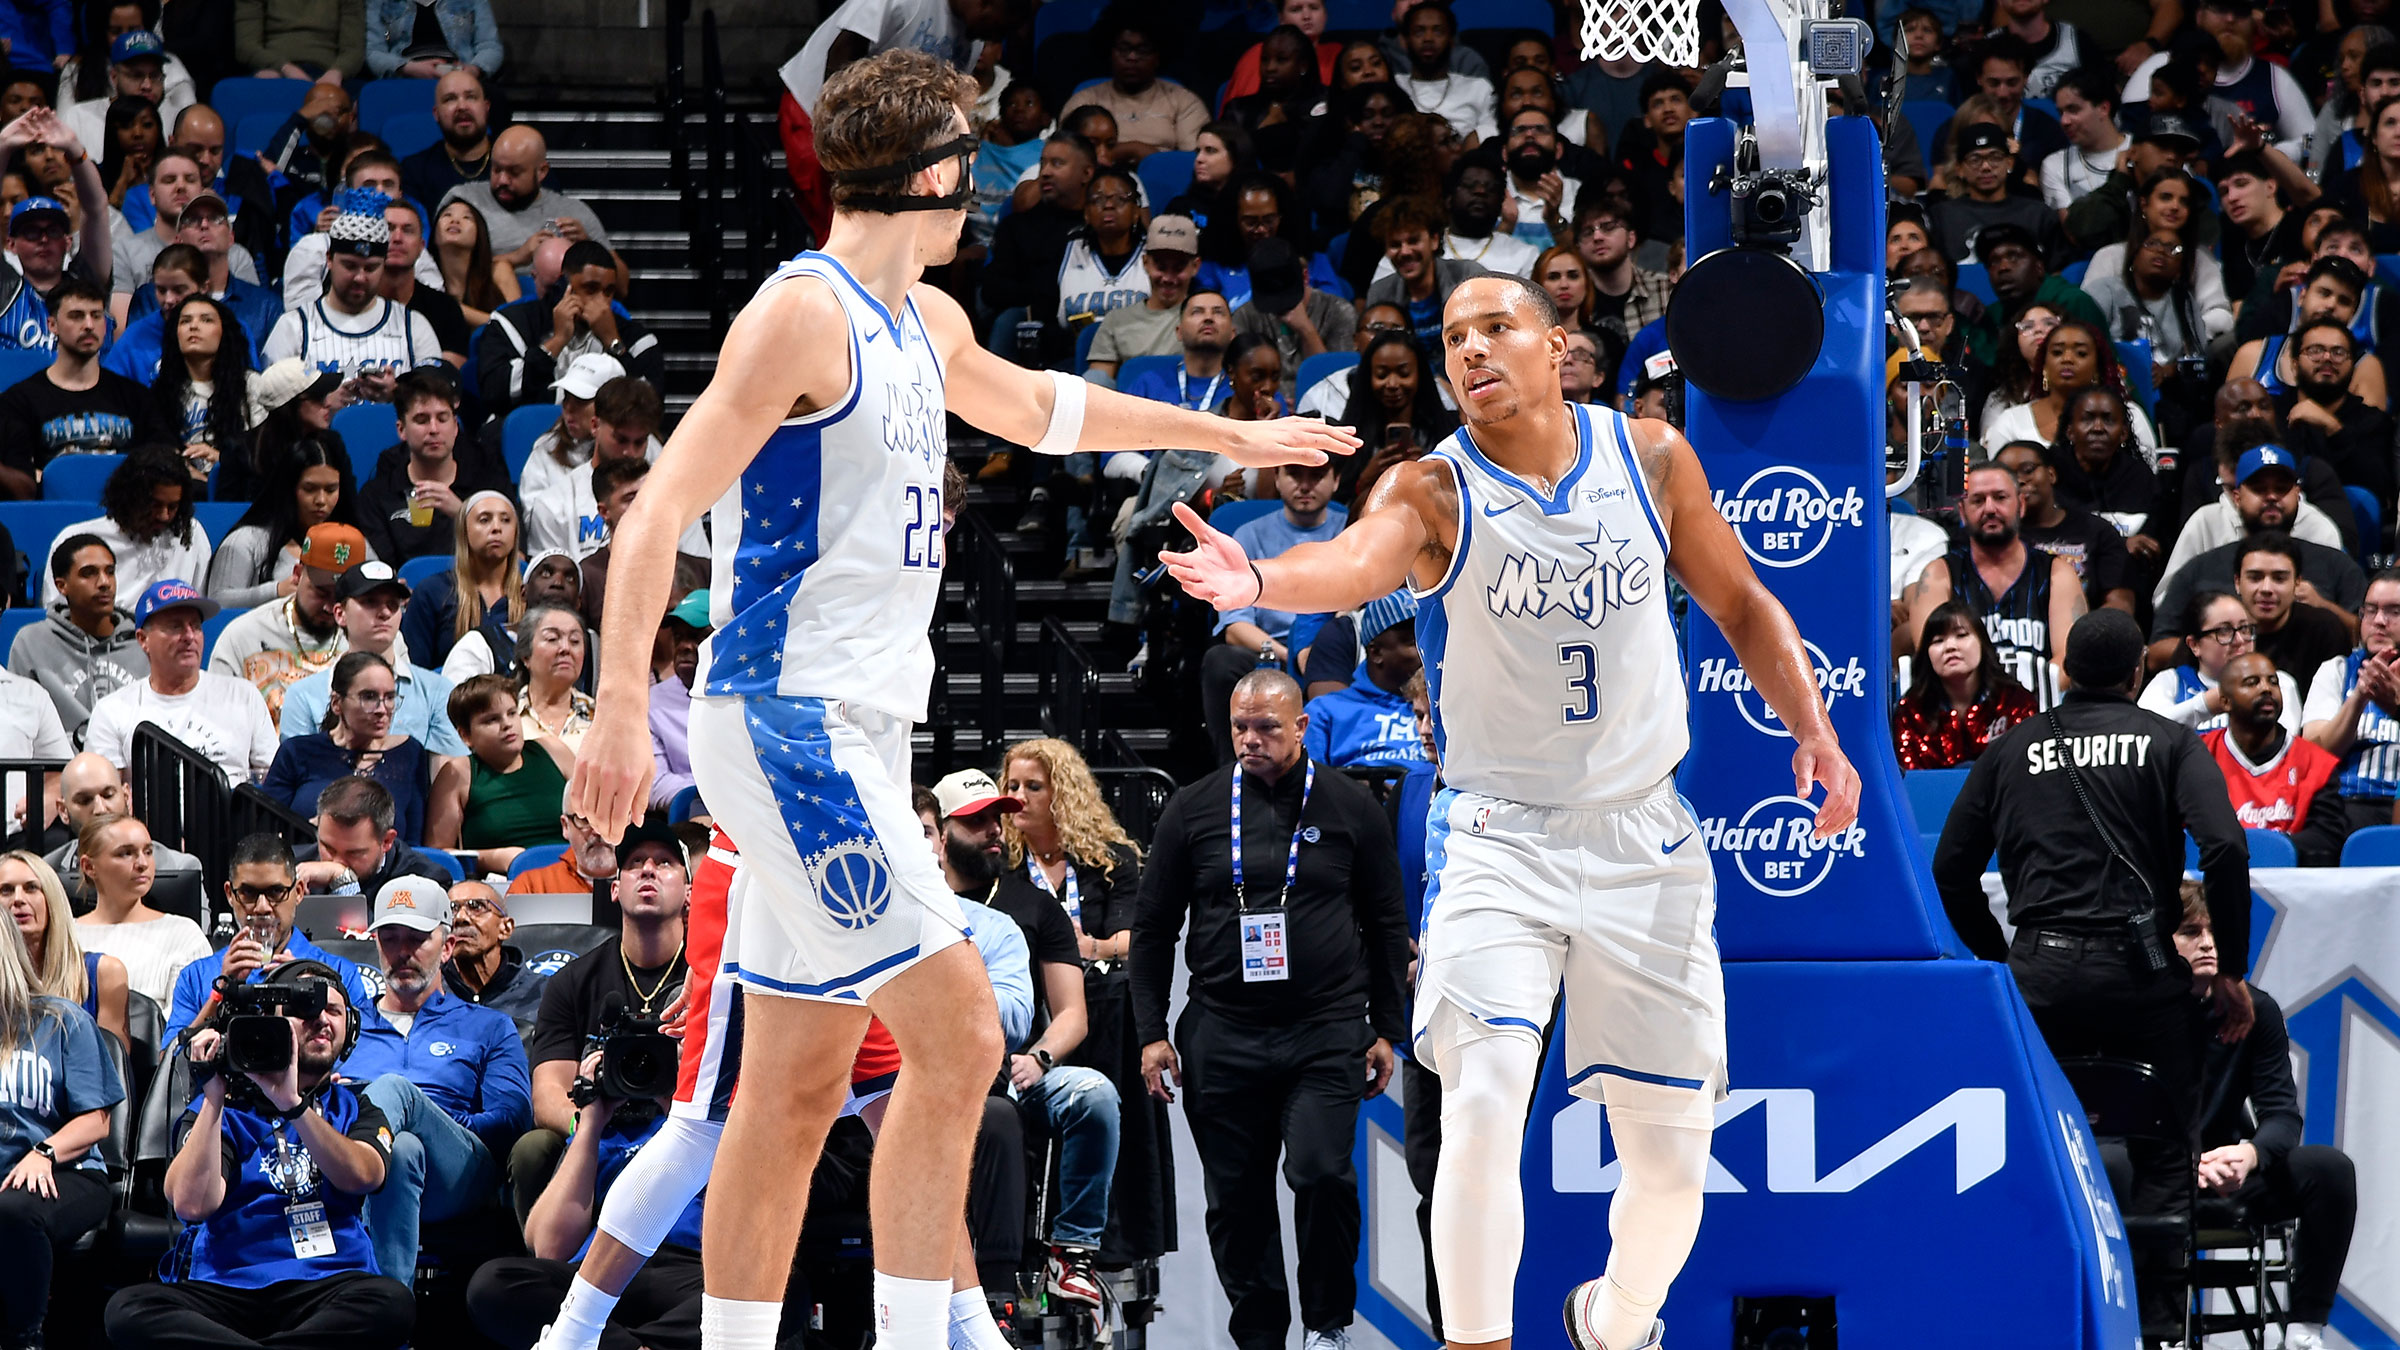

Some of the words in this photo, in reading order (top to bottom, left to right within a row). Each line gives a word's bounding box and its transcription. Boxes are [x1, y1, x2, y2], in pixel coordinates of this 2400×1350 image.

[1581, 487, 1627, 503] Disney
[1784, 487, 1864, 529] Rock
[901, 482, 941, 571] 22
[1763, 532, 1804, 550] BET
[1557, 641, 1601, 726] 3
[1813, 657, 1867, 698] ock
[1700, 817, 1784, 851] Hard
[1786, 817, 1867, 858] Rock
[1764, 861, 1805, 879] BET
[292, 1209, 321, 1226] STAFF
